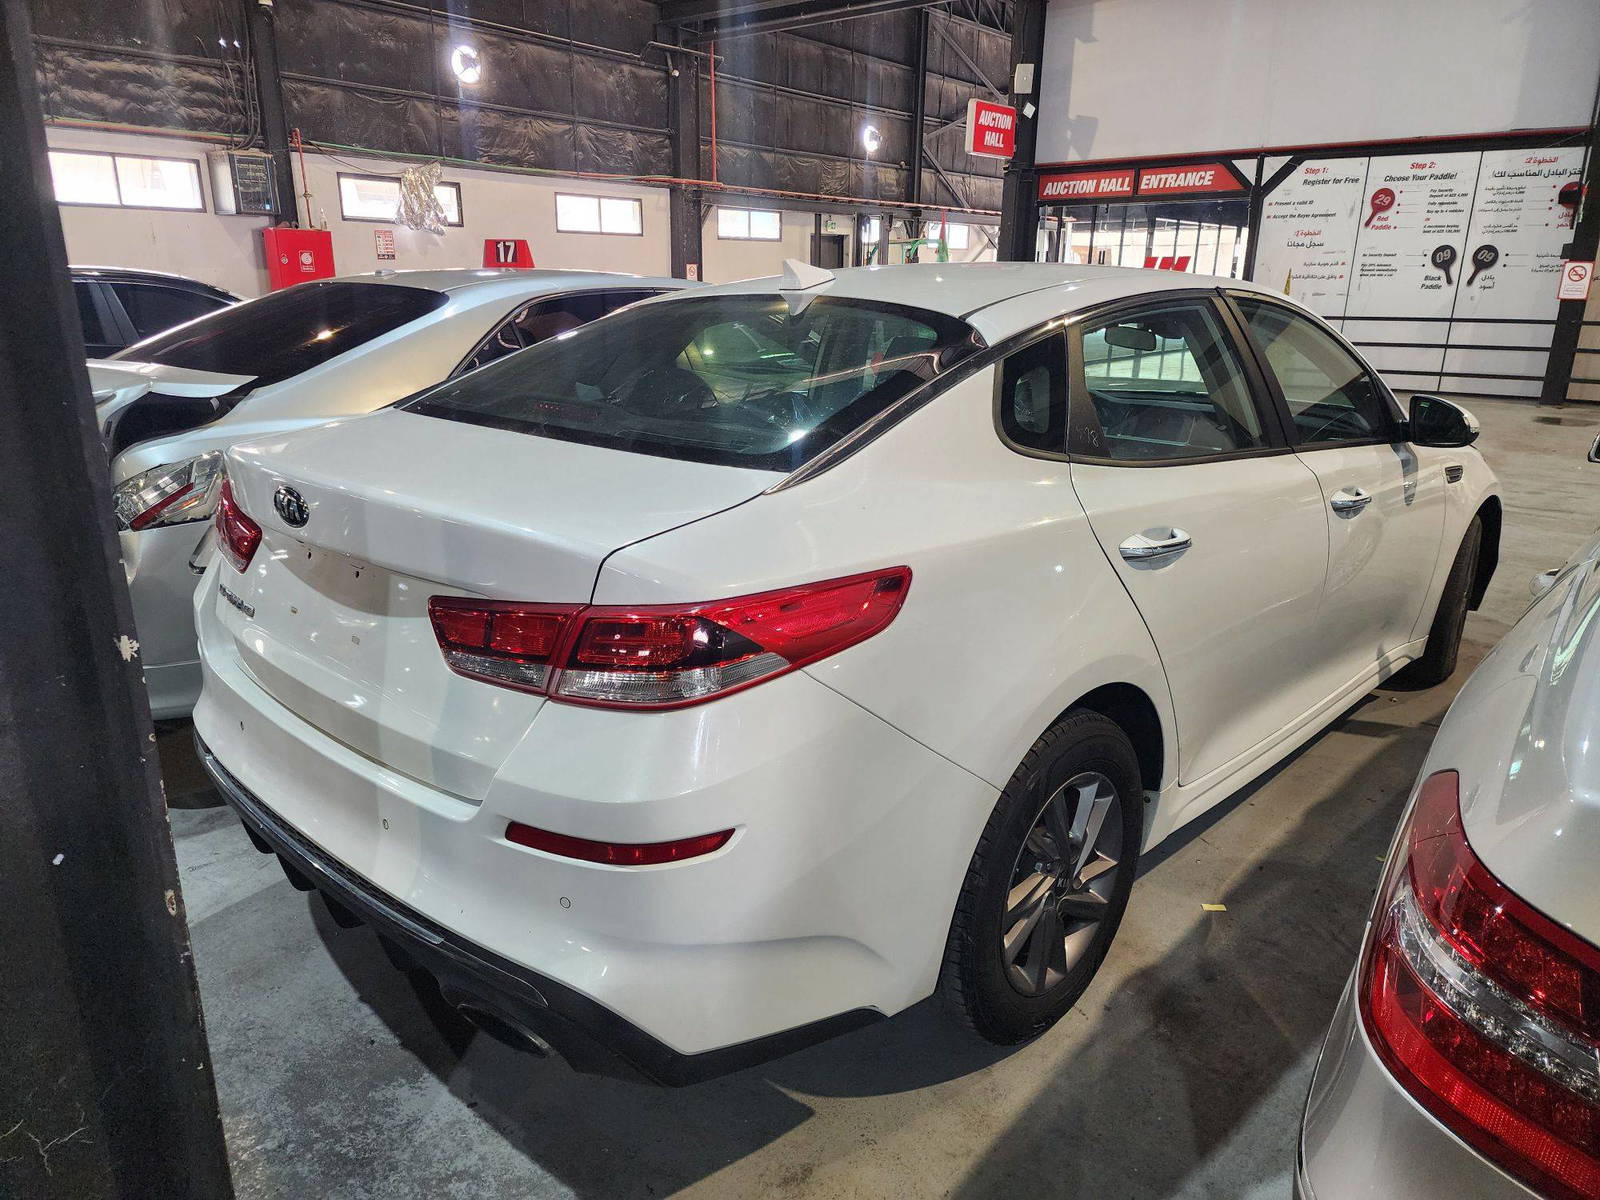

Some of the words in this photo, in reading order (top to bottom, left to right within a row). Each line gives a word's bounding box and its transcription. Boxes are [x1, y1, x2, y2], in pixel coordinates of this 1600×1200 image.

[978, 110, 1012, 130] AUCTION
[984, 131, 1004, 148] HALL
[1043, 179, 1096, 195] AUCTION
[1098, 177, 1130, 192] HALL
[1140, 170, 1214, 190] ENTRANCE
[1374, 194, 1391, 206] 29
[497, 241, 515, 263] 17
[1436, 249, 1451, 263] 09
[1478, 249, 1494, 262] 09
